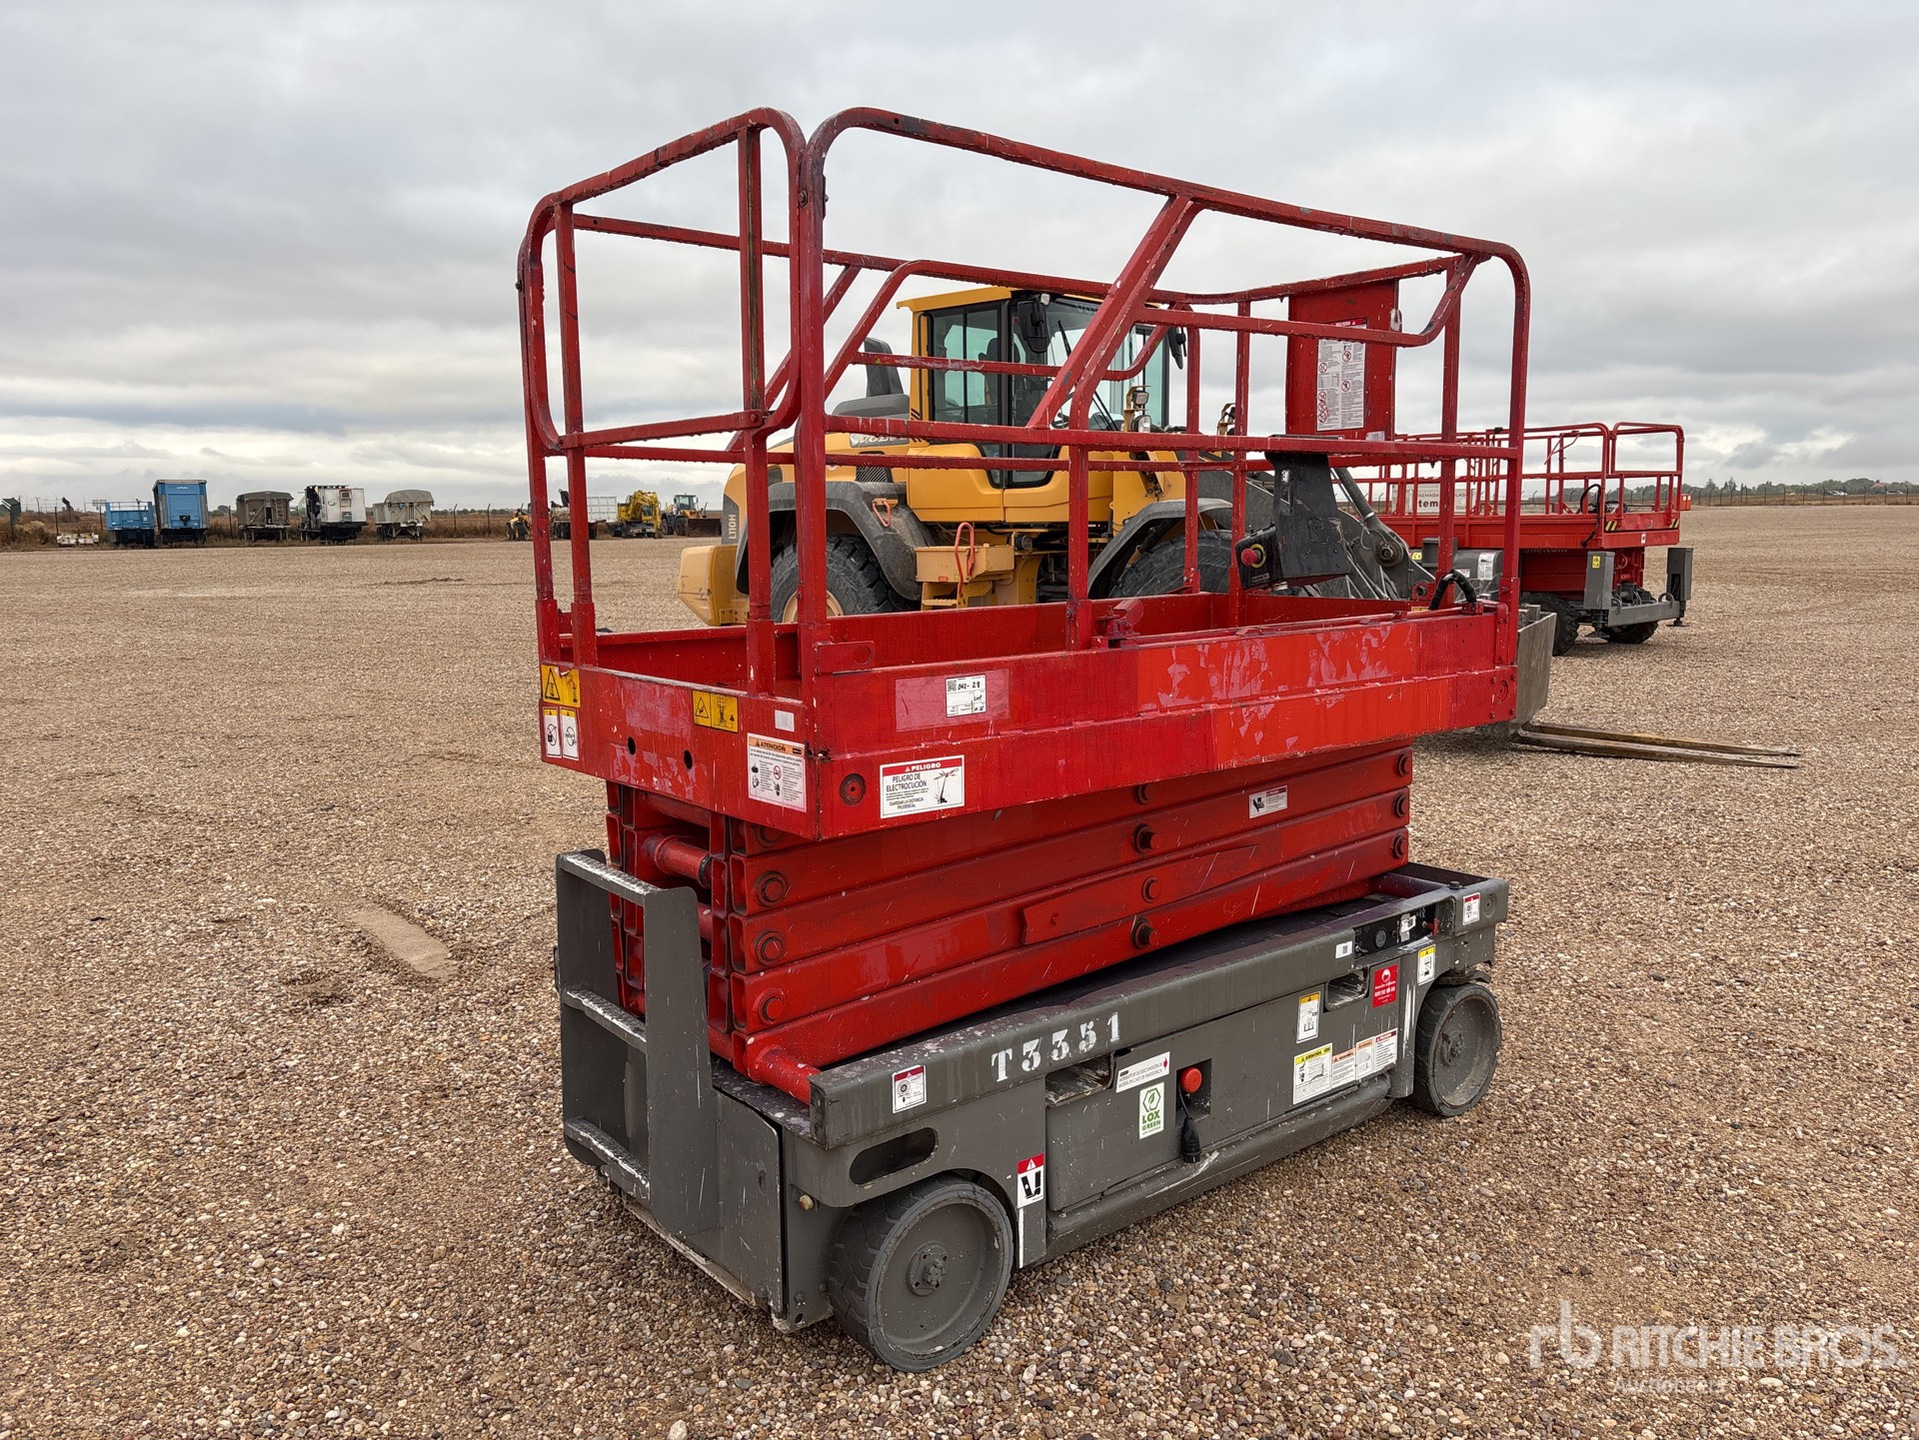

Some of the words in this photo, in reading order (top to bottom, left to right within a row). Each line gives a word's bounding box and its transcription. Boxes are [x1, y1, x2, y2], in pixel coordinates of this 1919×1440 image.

[728, 514, 737, 540] L110H
[911, 762, 942, 772] PELIGRO
[892, 774, 913, 784] PELIGRO
[914, 772, 921, 780] DE
[886, 779, 928, 793] ELECTROCUCIÓN
[990, 1011, 1121, 1083] T3351
[1142, 1109, 1161, 1124] LOX
[1142, 1119, 1161, 1131] GREEN
